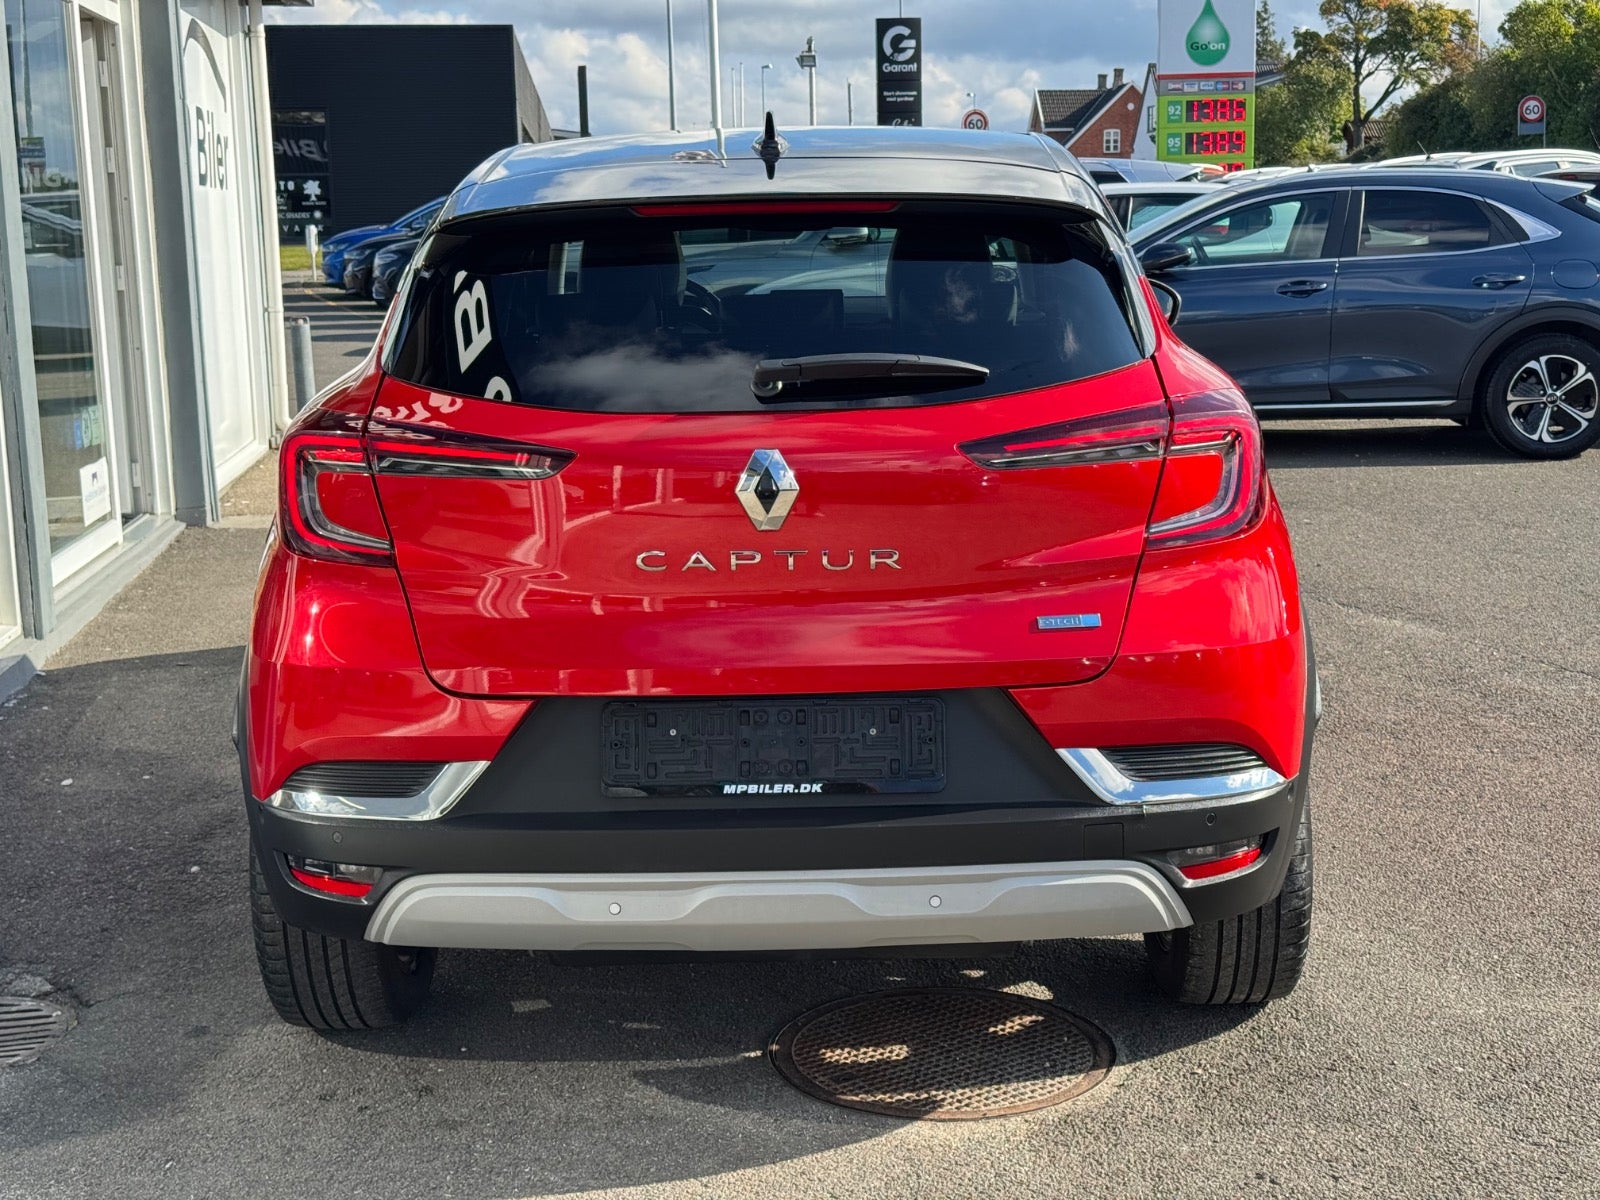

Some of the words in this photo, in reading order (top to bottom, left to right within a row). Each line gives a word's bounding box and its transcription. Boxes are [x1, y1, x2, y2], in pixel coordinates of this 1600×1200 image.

[1190, 41, 1226, 51] Go'on
[882, 62, 917, 73] Garant
[1168, 105, 1181, 115] 92
[1524, 104, 1540, 115] 60
[968, 118, 984, 130] 60
[1167, 137, 1181, 147] 95
[196, 105, 228, 191] Biler
[635, 549, 902, 571] CAPTUR
[723, 783, 823, 794] MPBILER.DK
